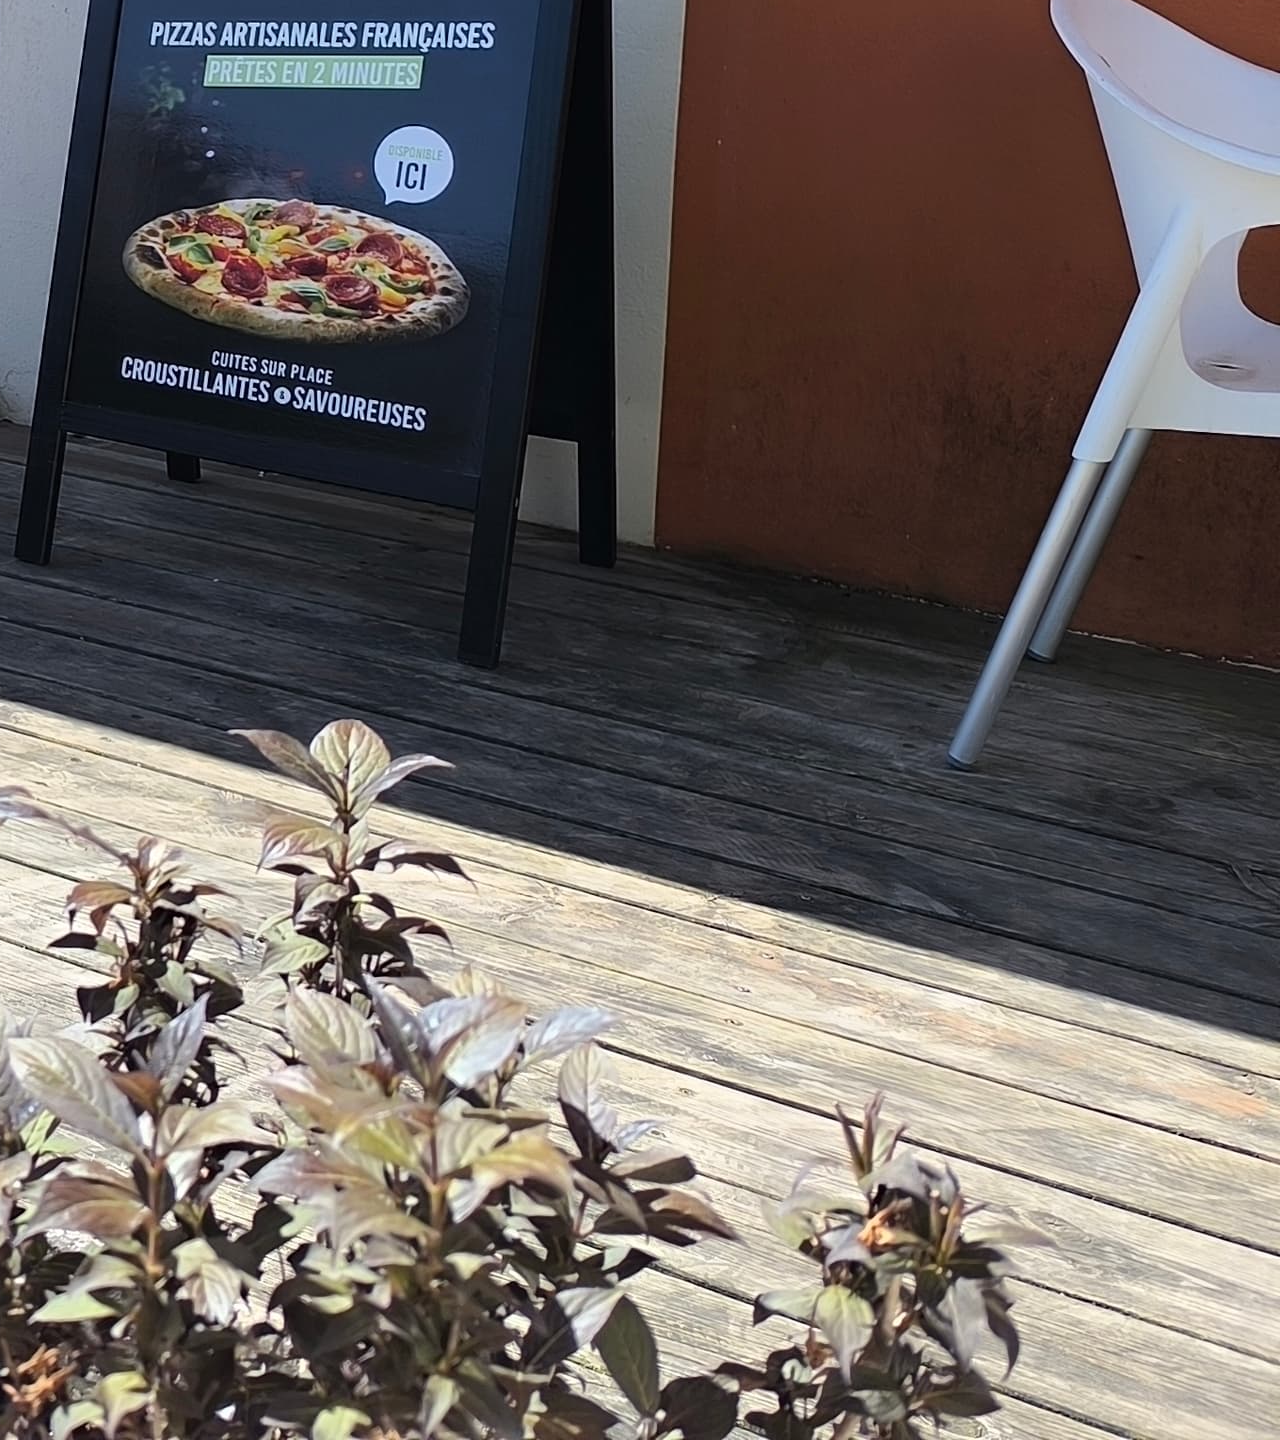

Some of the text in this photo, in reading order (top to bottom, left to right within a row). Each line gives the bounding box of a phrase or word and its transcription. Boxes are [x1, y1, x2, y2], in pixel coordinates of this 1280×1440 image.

[150, 21, 496, 53] PIZZAS ARTISANALES FRANÇAISES
[207, 56, 419, 86] PRÊTES EN 2 MINUTES
[388, 144, 444, 161] DISPONIBLE
[395, 160, 427, 190] ICI
[211, 350, 334, 386] CUITES SUR PLACE
[121, 356, 271, 403] CROUSTILLANTES
[292, 386, 427, 431] SAVOUREUSES
